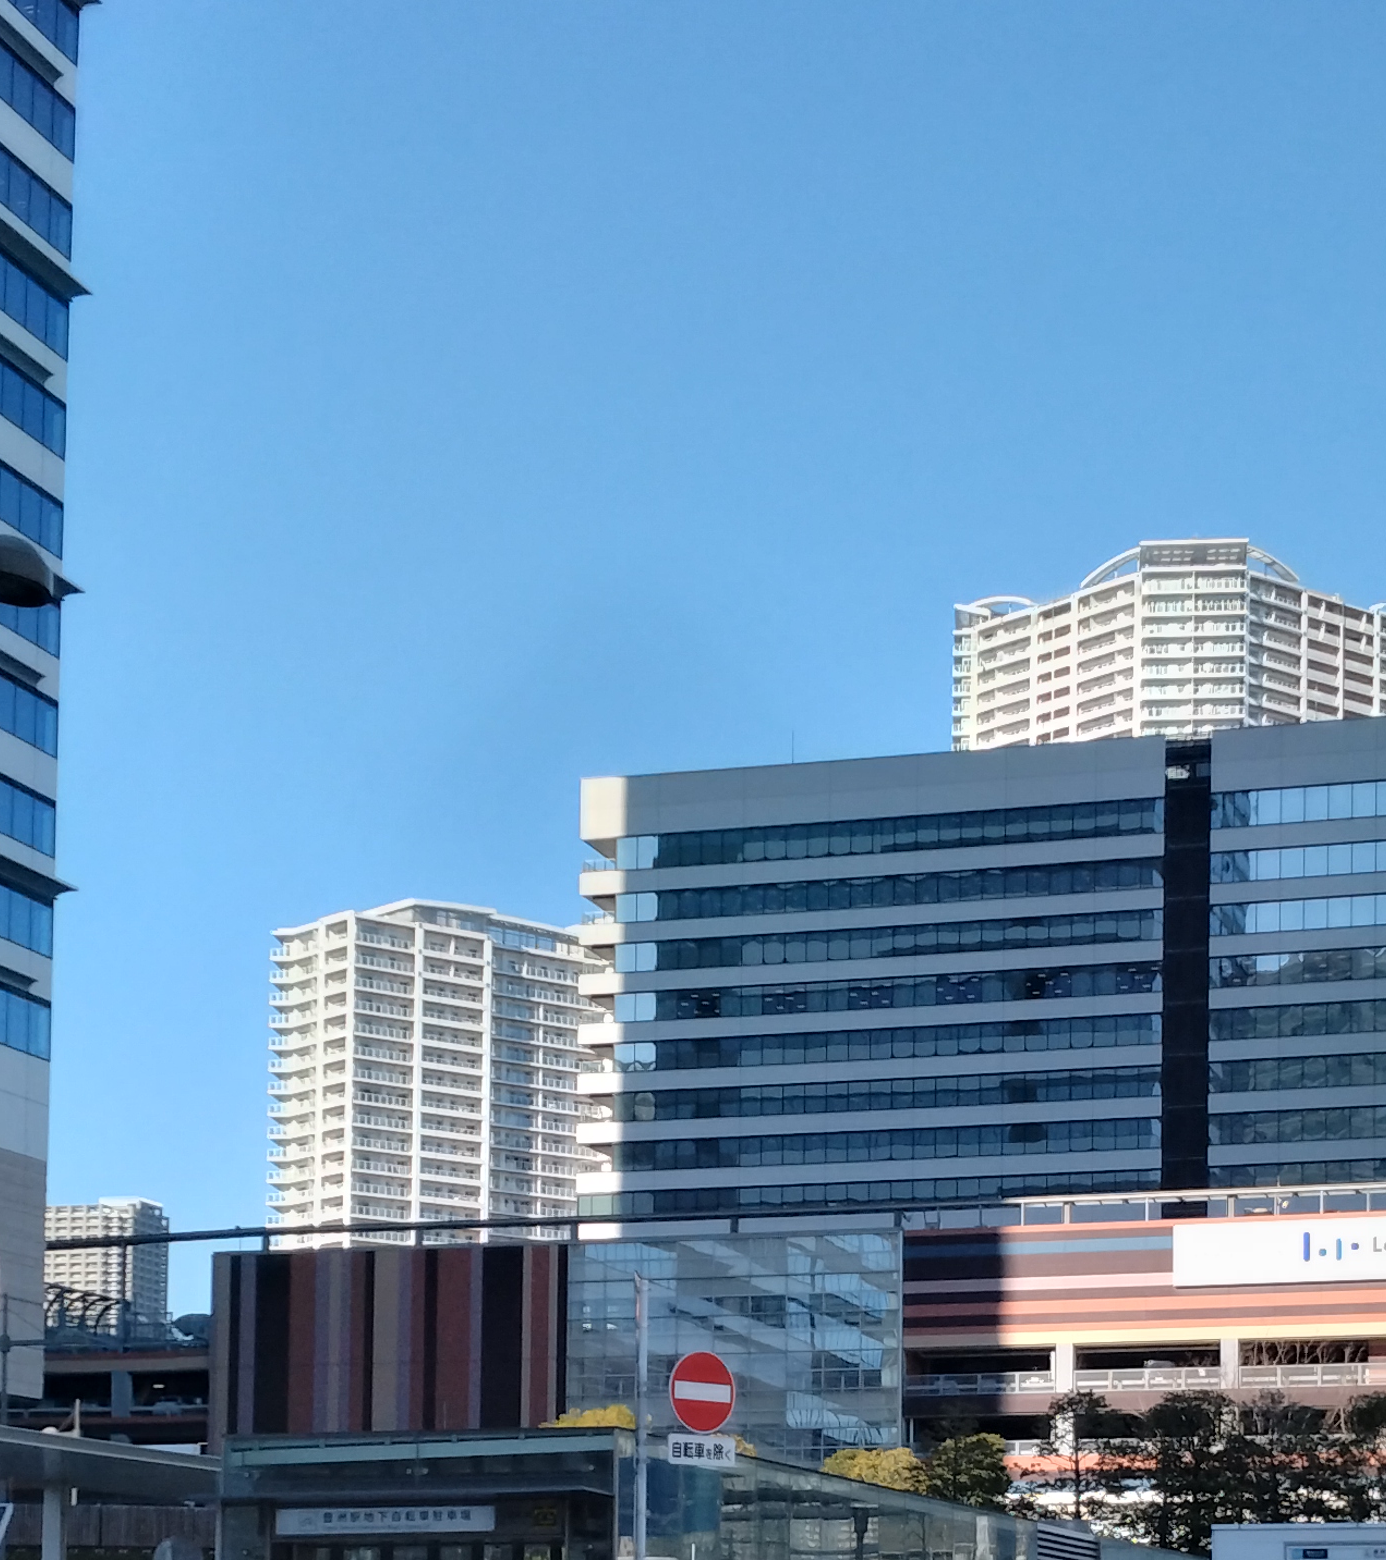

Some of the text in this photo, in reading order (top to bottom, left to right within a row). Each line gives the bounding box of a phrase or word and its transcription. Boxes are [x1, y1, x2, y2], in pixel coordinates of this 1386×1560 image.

[672, 1441, 732, 1461] 自転車を除く
